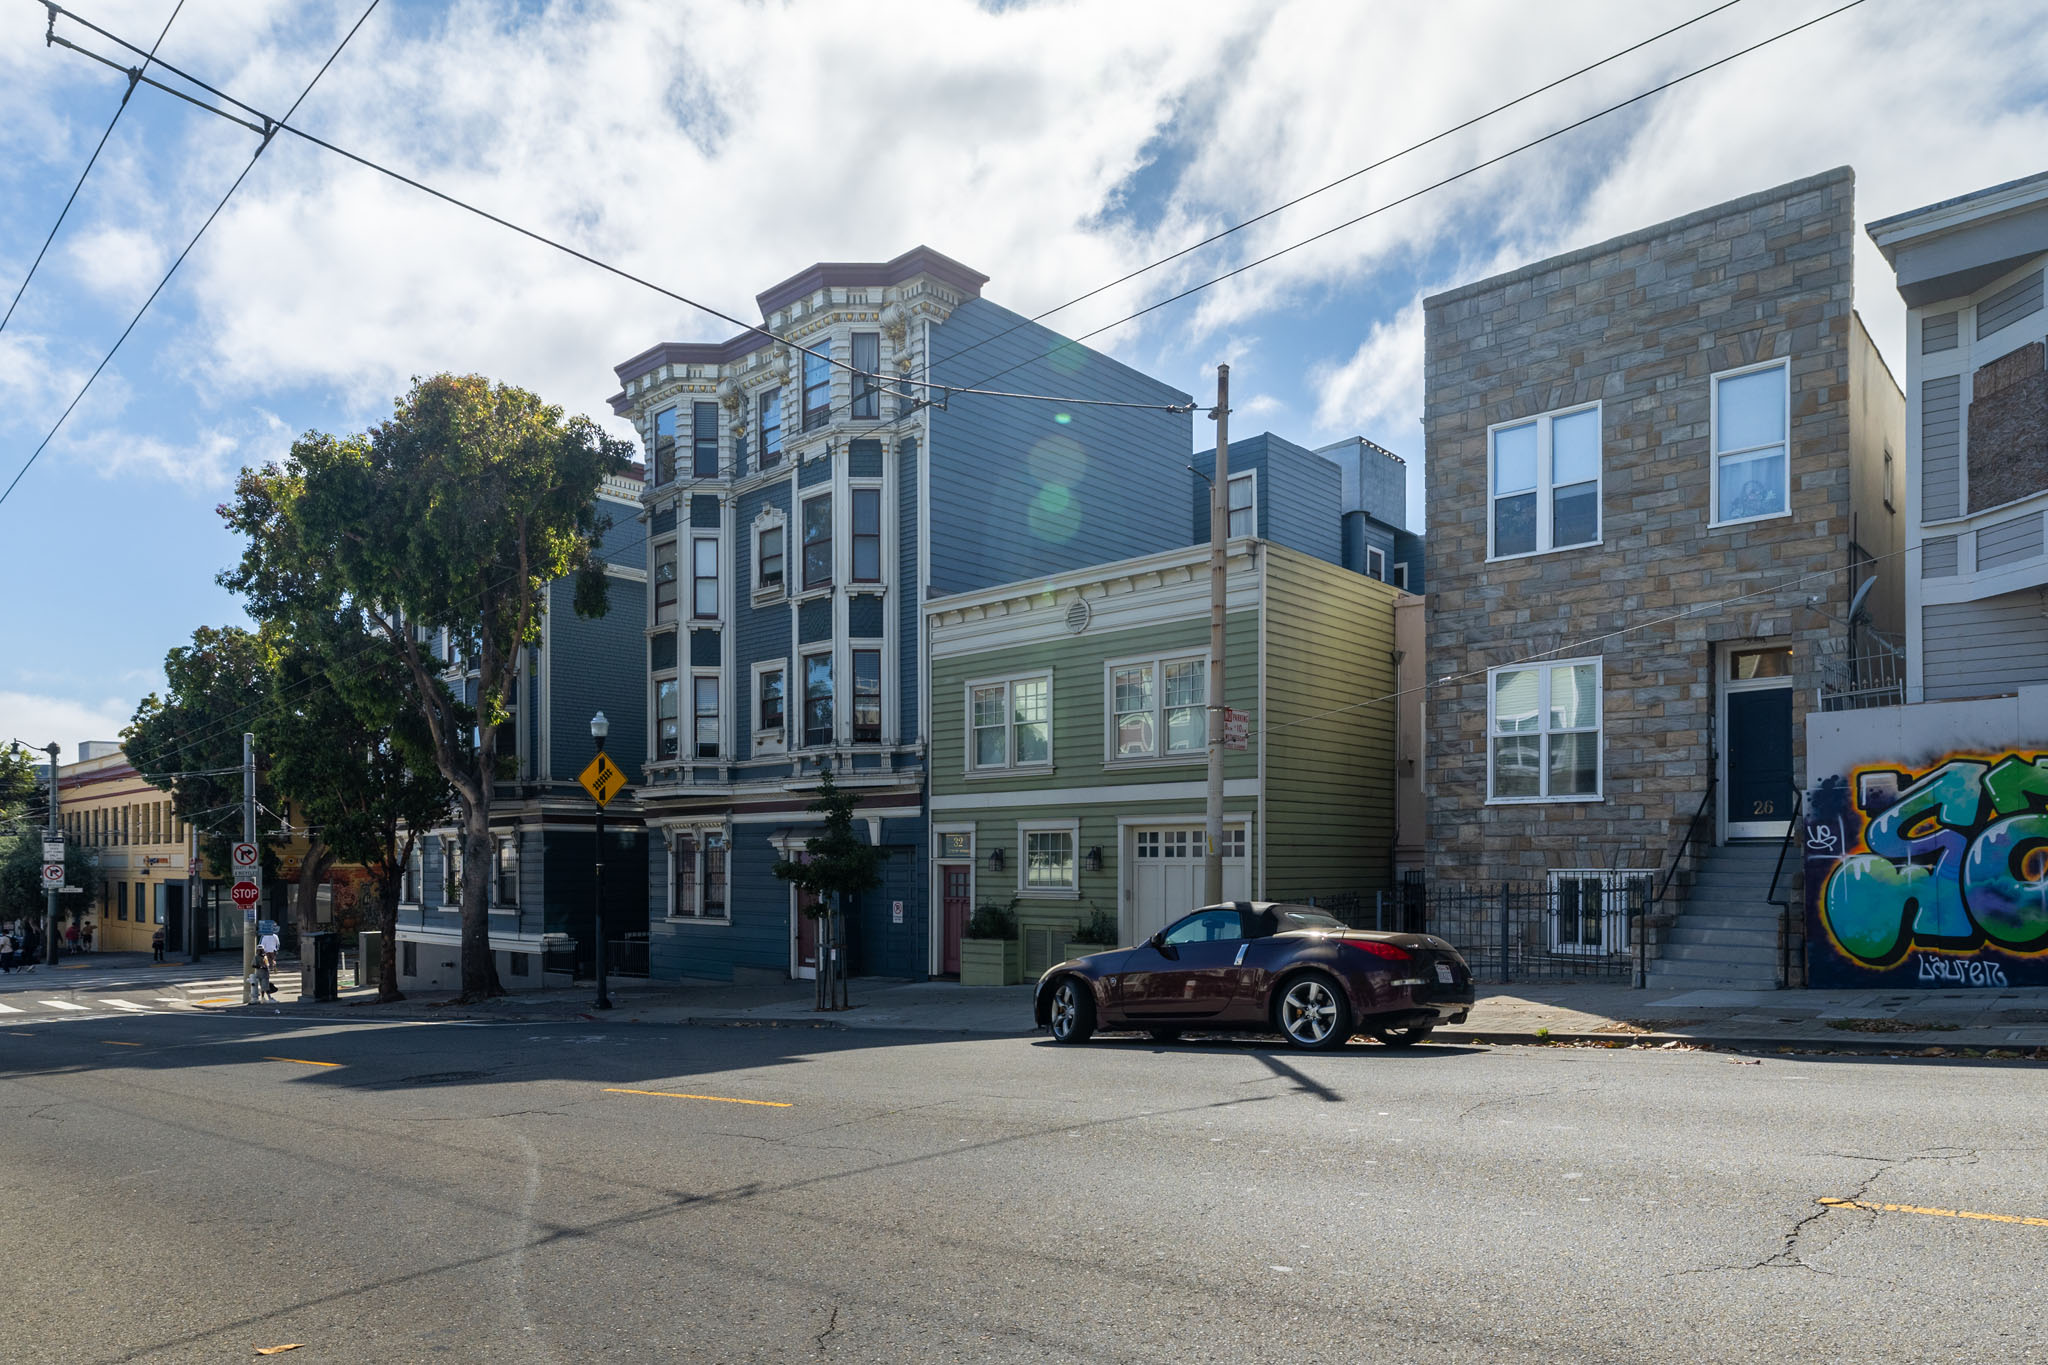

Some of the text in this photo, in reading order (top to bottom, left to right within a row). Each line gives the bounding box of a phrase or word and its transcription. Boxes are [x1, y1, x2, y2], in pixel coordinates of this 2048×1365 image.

[1753, 800, 1774, 815] 26
[954, 837, 963, 848] 32
[233, 889, 258, 899] STOP
